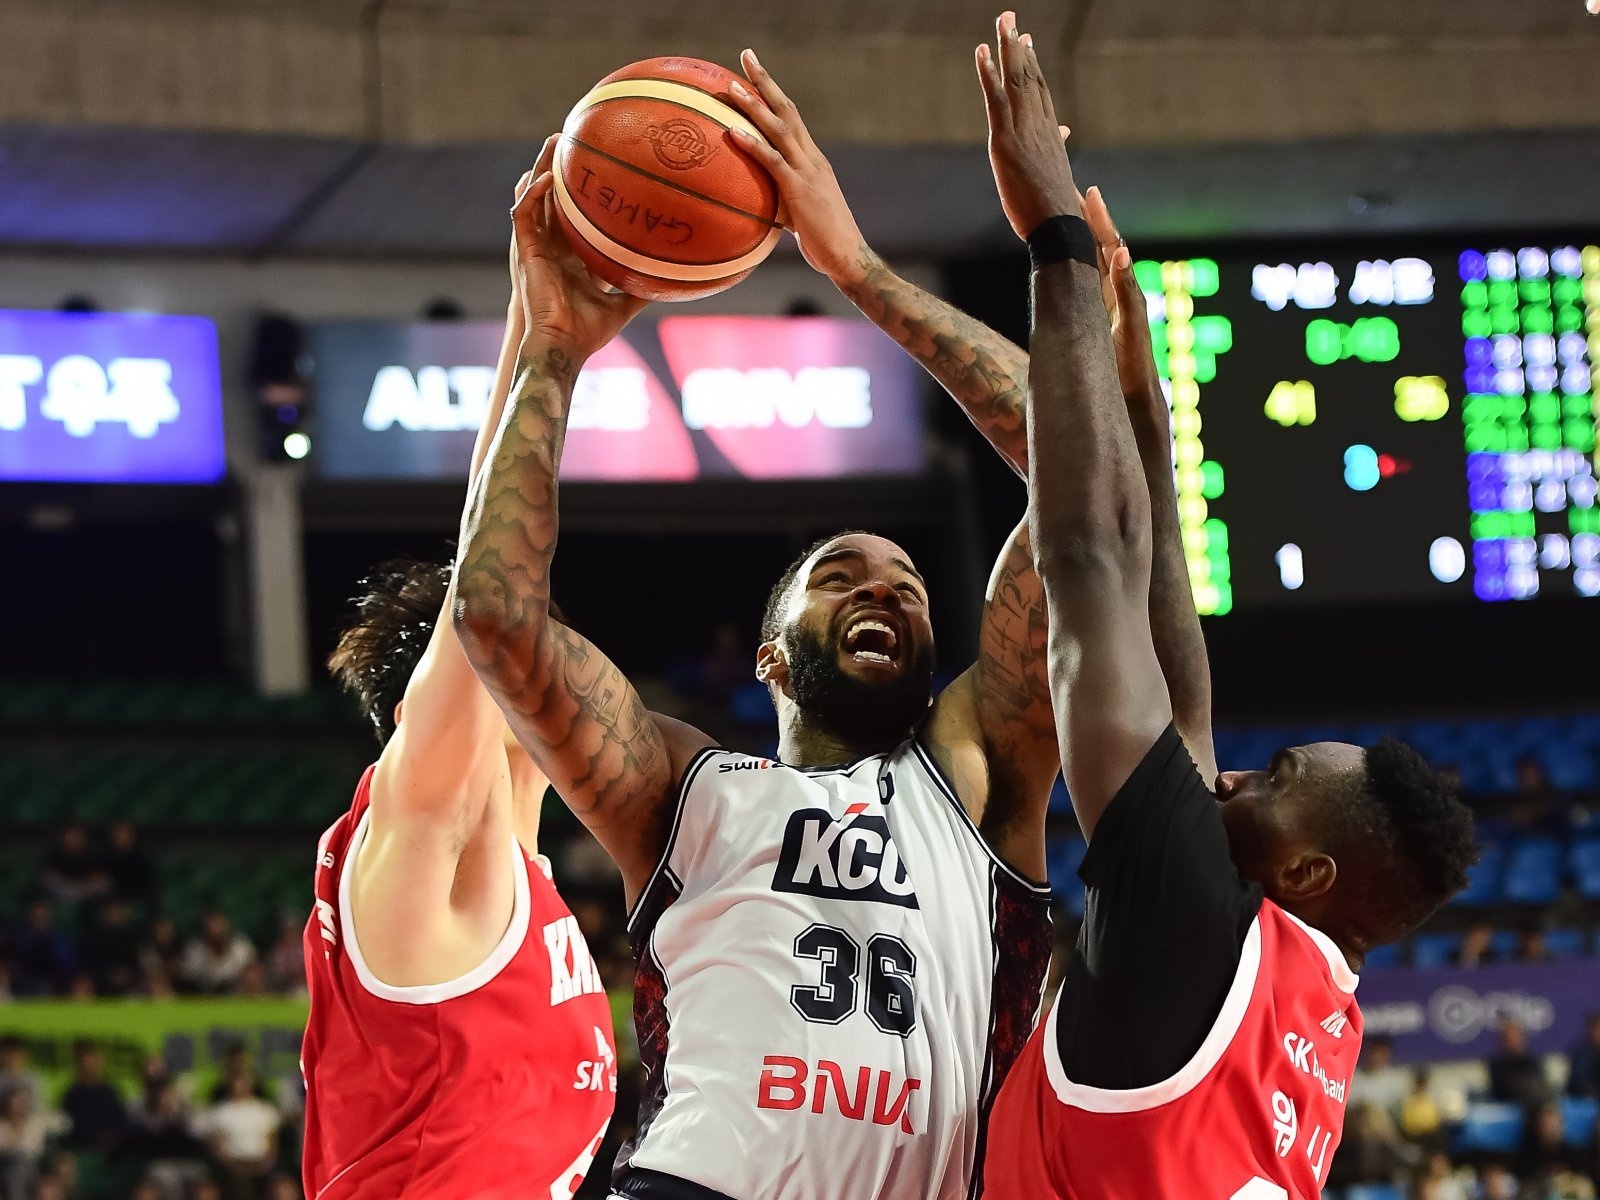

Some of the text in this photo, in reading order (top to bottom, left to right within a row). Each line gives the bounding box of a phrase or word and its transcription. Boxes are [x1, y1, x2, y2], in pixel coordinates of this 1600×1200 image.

[790, 922, 917, 1039] 36
[573, 1061, 605, 1091] SK
[1283, 1031, 1314, 1074] SK
[757, 1055, 921, 1135] BNK
